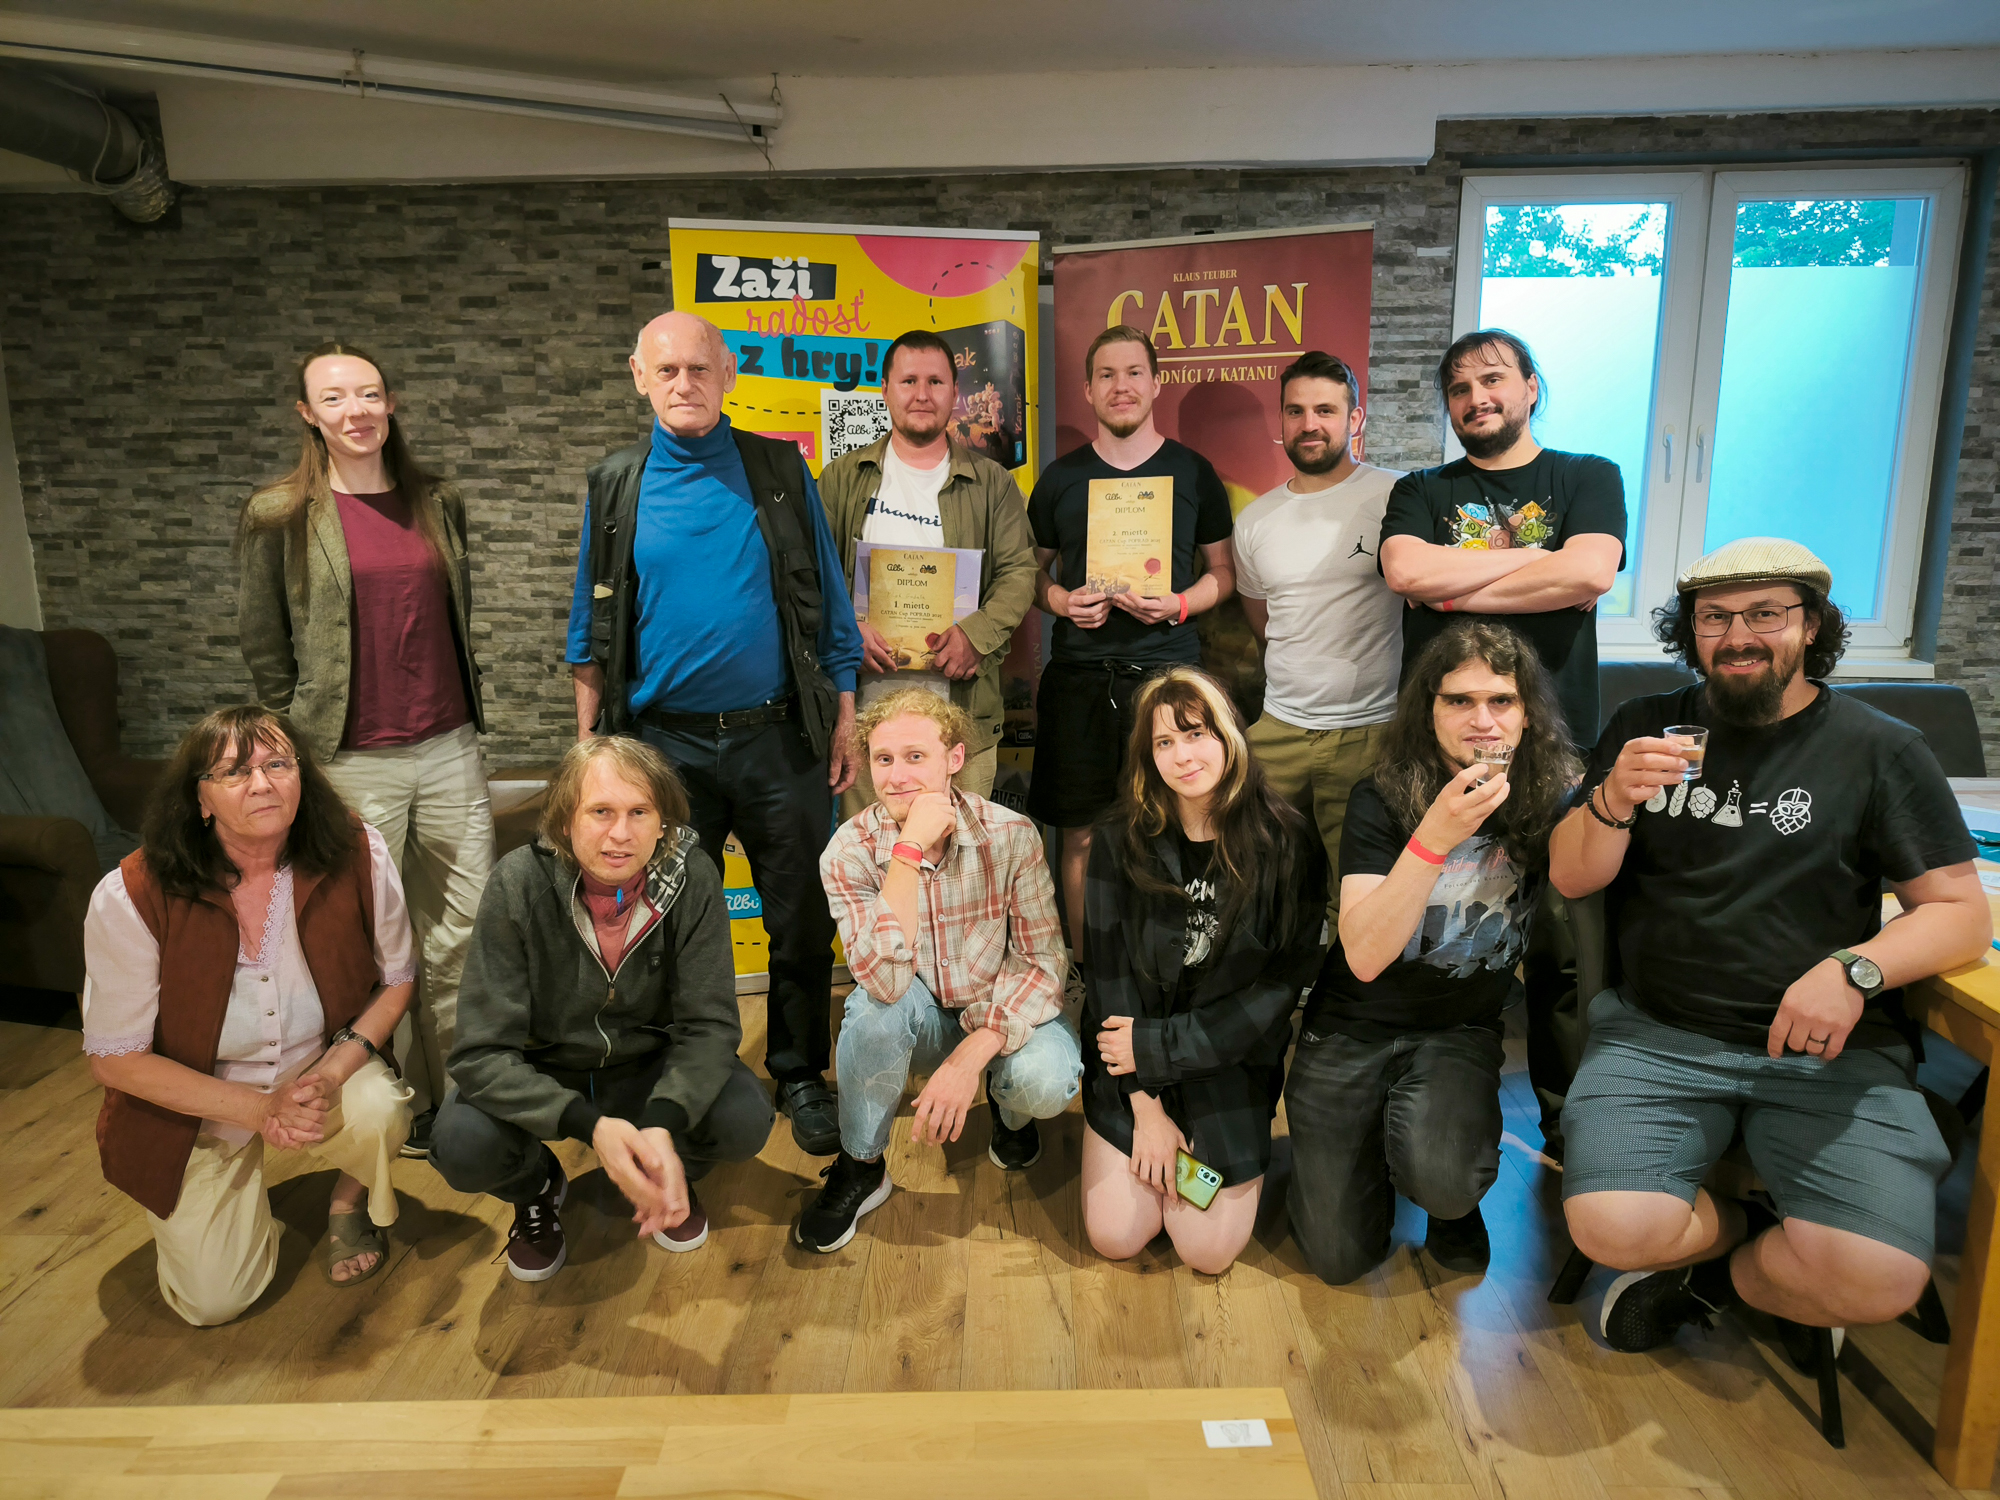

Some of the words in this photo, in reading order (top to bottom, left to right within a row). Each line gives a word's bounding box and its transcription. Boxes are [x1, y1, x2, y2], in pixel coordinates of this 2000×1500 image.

[712, 255, 813, 299] Zaži
[1173, 271, 1200, 283] KLAUS
[1203, 269, 1237, 281] TEUBER
[746, 289, 871, 338] radosť
[1106, 282, 1309, 350] CATAN
[740, 345, 764, 376] z
[781, 338, 878, 391] hry!
[1160, 365, 1202, 384] DNÍCI
[1207, 368, 1215, 383] Z
[1220, 365, 1278, 383] KATANU
[1115, 506, 1146, 514] DIPLOM
[897, 578, 928, 587] DIPLOM
[1033, 642, 1042, 691] ATAN
